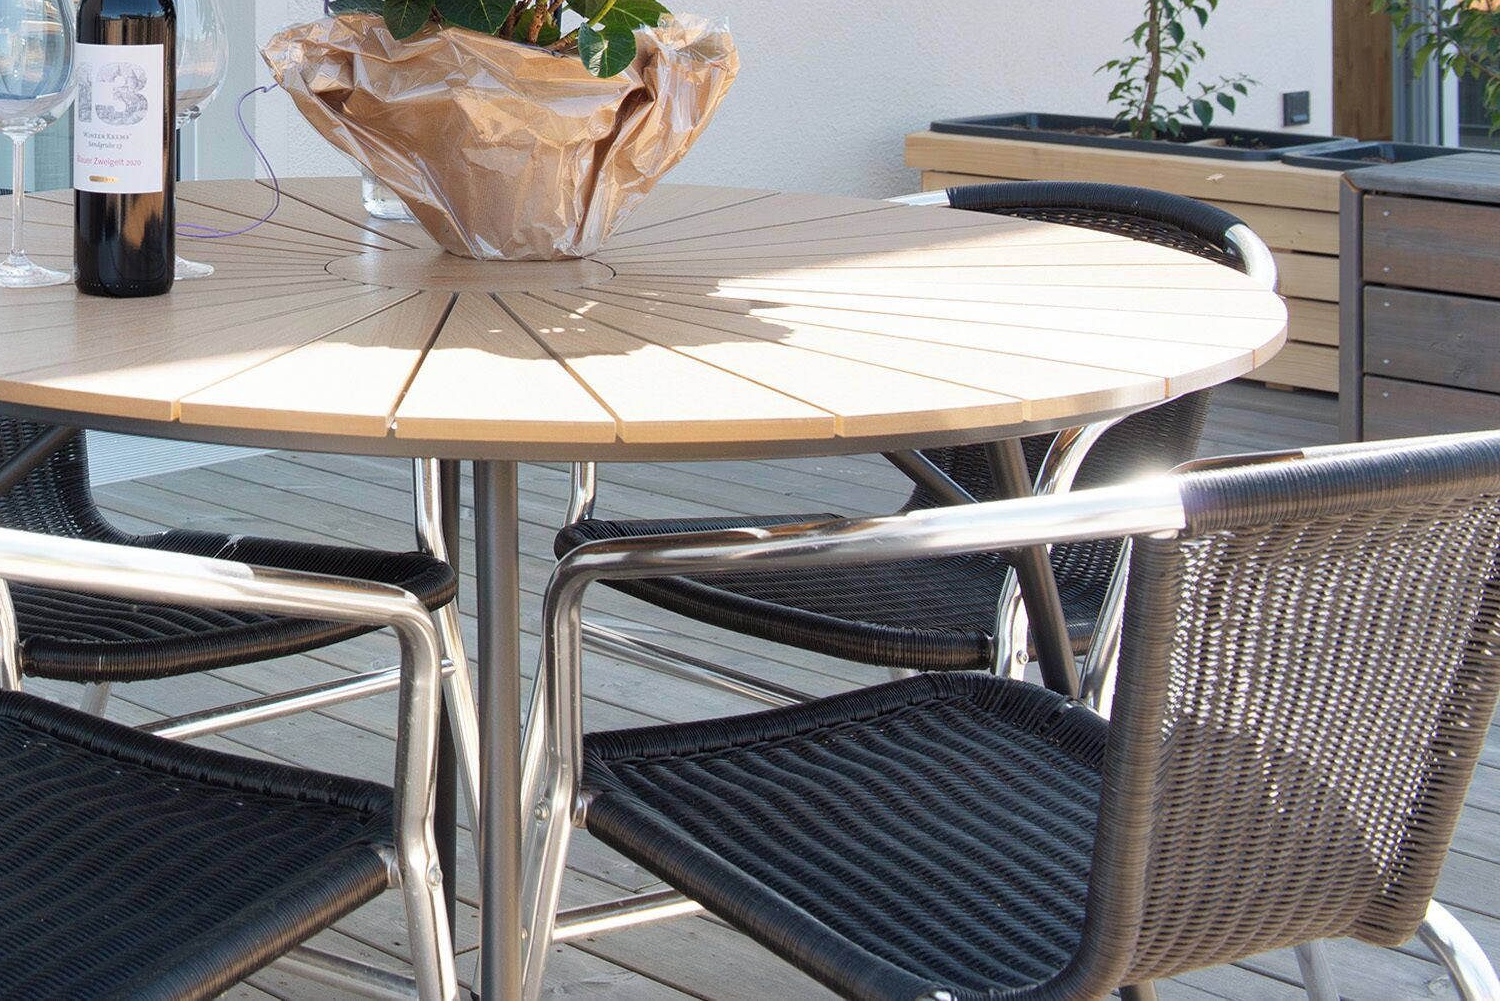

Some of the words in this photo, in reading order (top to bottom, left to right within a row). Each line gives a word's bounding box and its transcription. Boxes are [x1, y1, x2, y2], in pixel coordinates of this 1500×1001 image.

[76, 62, 149, 126] 13
[93, 157, 124, 168] Zweigelt
[125, 159, 142, 167] 2020
